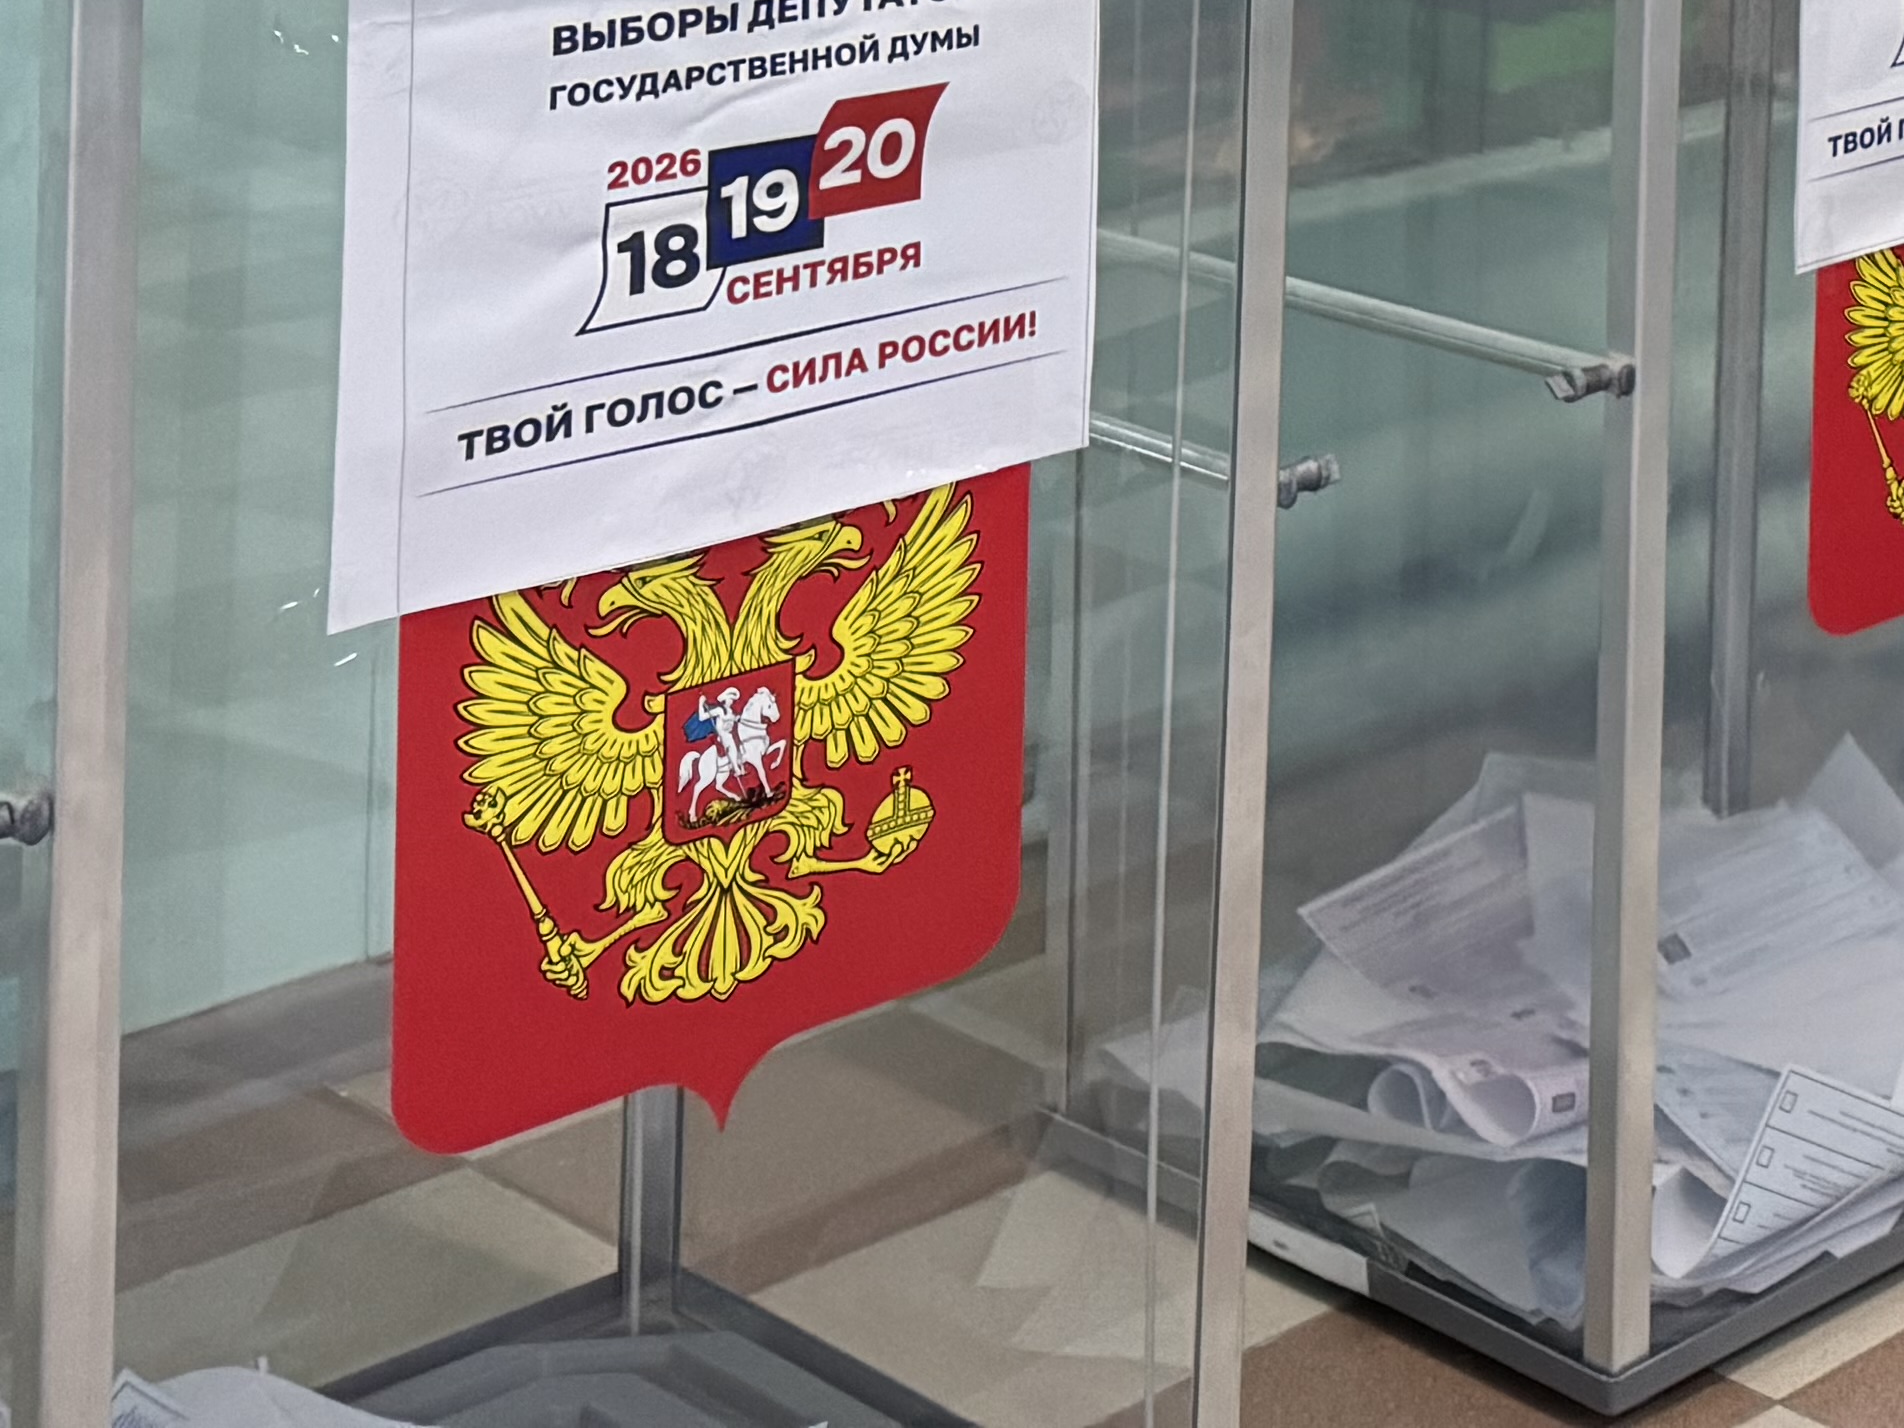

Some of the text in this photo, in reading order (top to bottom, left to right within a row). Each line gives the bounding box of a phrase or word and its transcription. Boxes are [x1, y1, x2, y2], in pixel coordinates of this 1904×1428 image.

[552, 3, 739, 56] ВЫБОРЫ
[549, 25, 981, 110] ГОСУДАРСТВЕННОЙ ДУМЫ
[607, 149, 702, 190] 2026
[1828, 118, 1892, 157] ТВОЙ
[616, 117, 915, 296] 18 19 20
[726, 242, 922, 306] СЕНТЯБРЯ
[457, 410, 572, 463] ТВОЙ
[584, 380, 724, 434] ГОЛОС
[766, 351, 868, 396] СИЛА
[878, 311, 1037, 372] РОССИИ!
